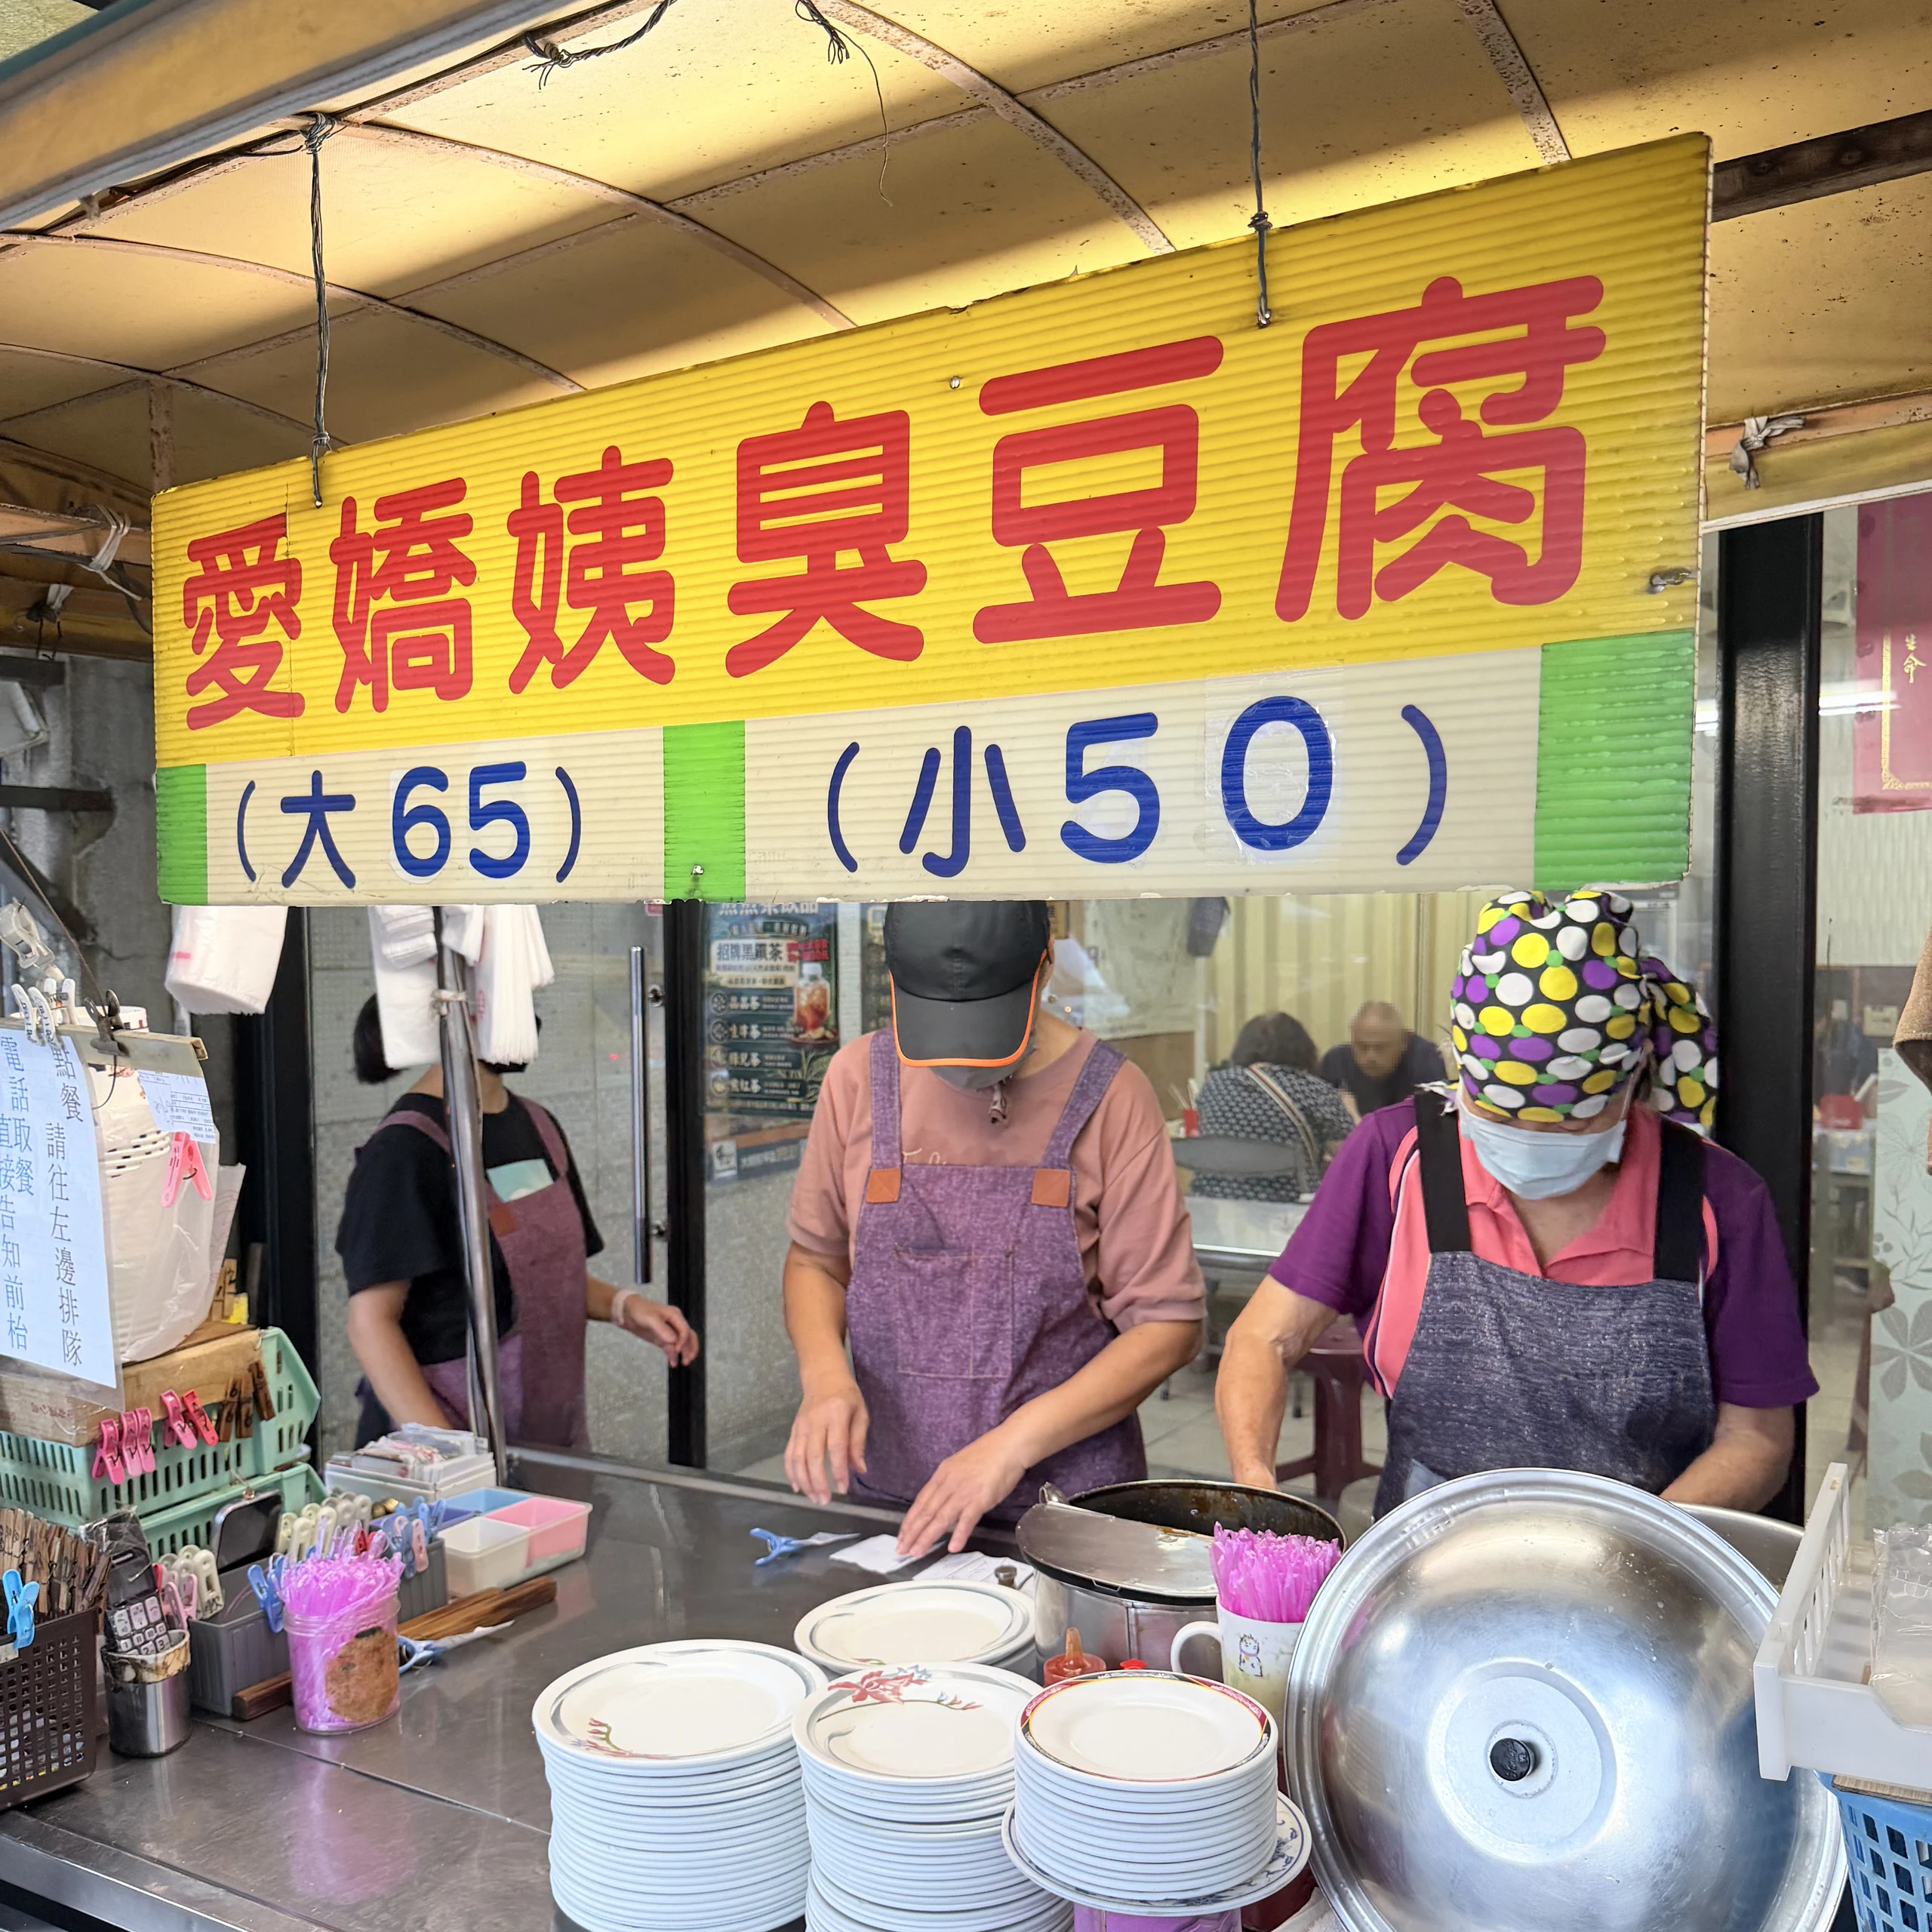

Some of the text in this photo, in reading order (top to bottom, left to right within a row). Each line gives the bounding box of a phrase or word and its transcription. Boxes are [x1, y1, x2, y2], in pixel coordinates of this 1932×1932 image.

[184, 276, 1607, 730] 愛嬌姨臭豆腐
[237, 761, 582, 889] (大65)
[1, 1036, 35, 1196] 電話取餐
[45, 1123, 82, 1367] 請往左邊排隊
